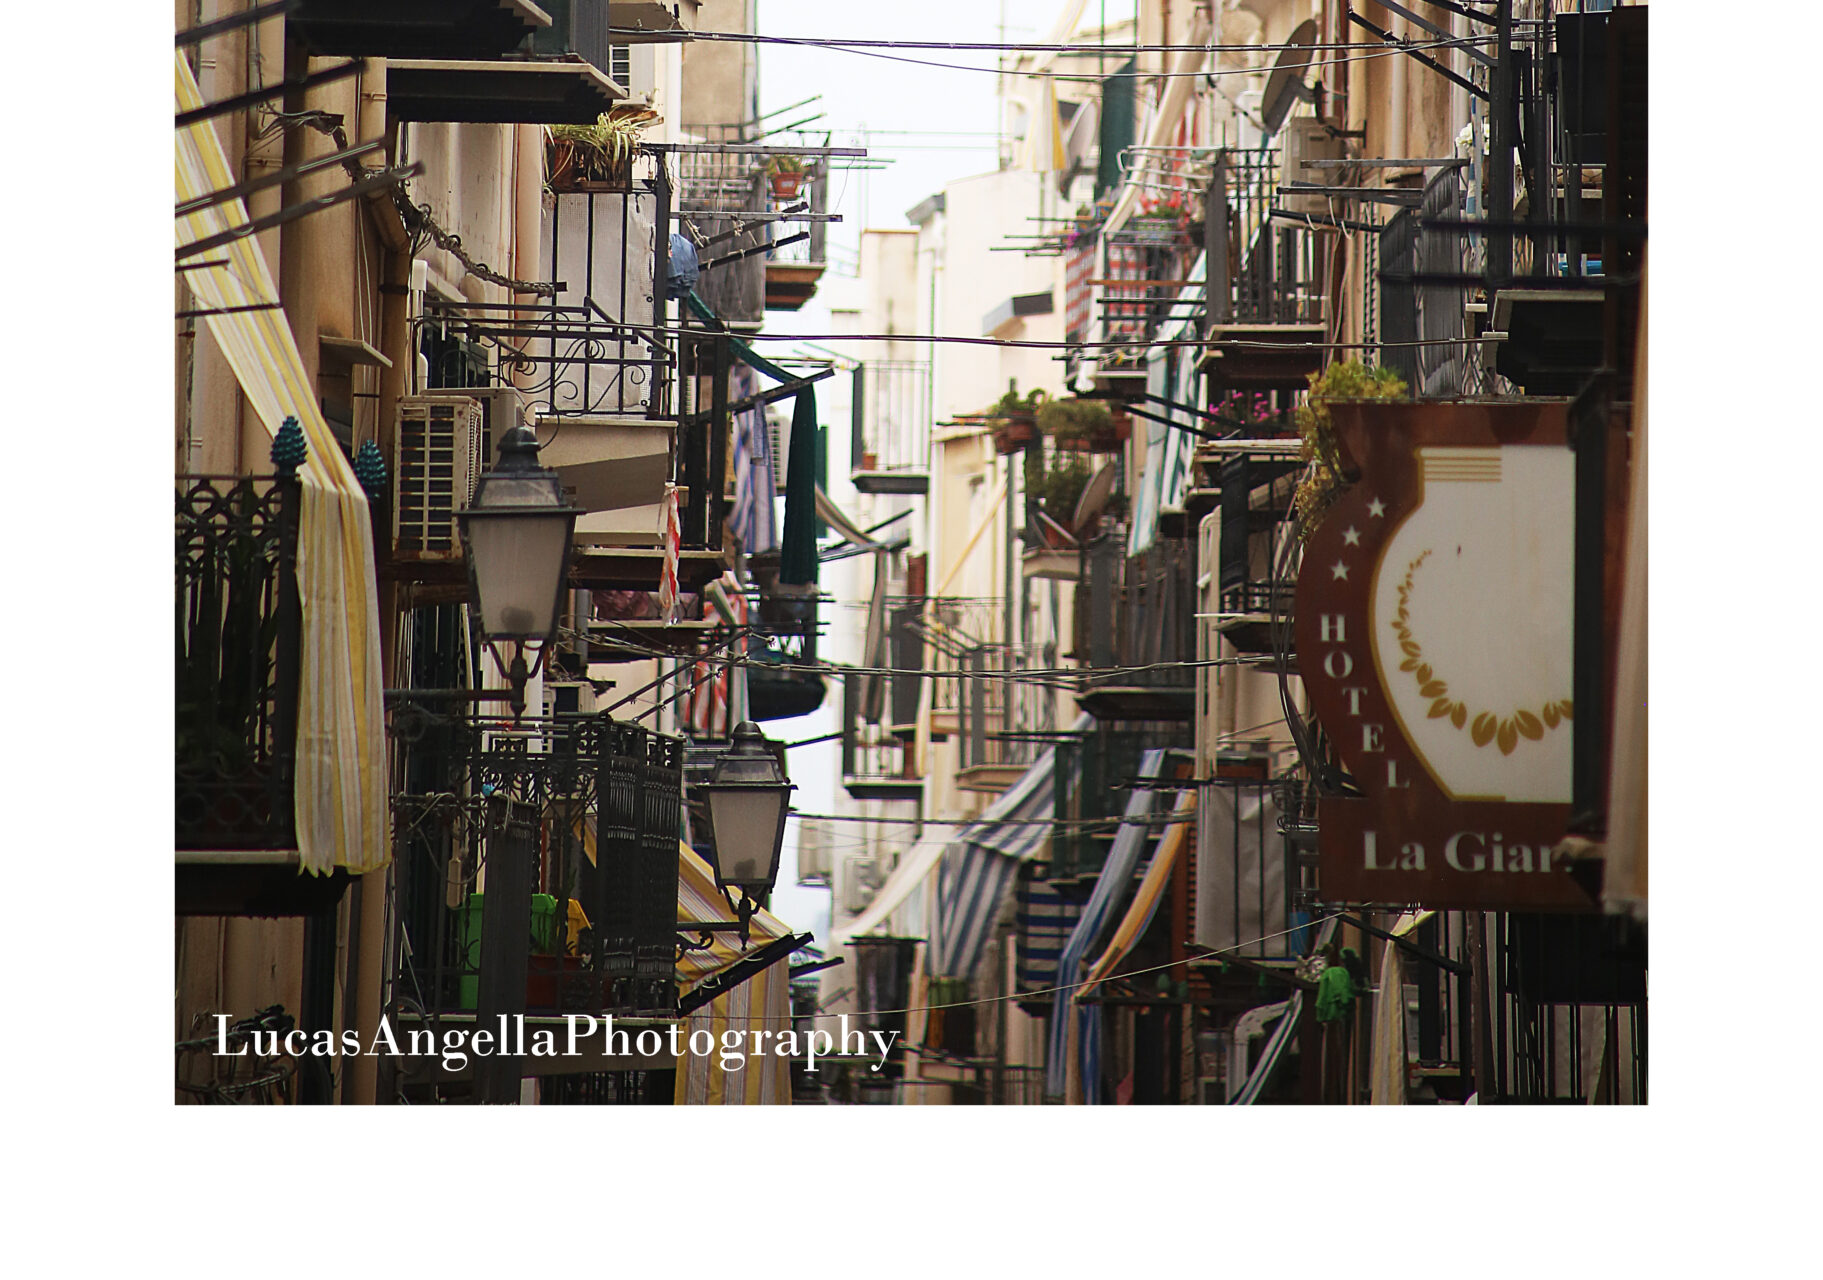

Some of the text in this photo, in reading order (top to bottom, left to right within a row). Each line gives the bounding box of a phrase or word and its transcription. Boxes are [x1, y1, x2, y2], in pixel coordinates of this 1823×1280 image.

[1320, 613, 1410, 788] HOTEL
[1363, 830, 1573, 873] La Giar
